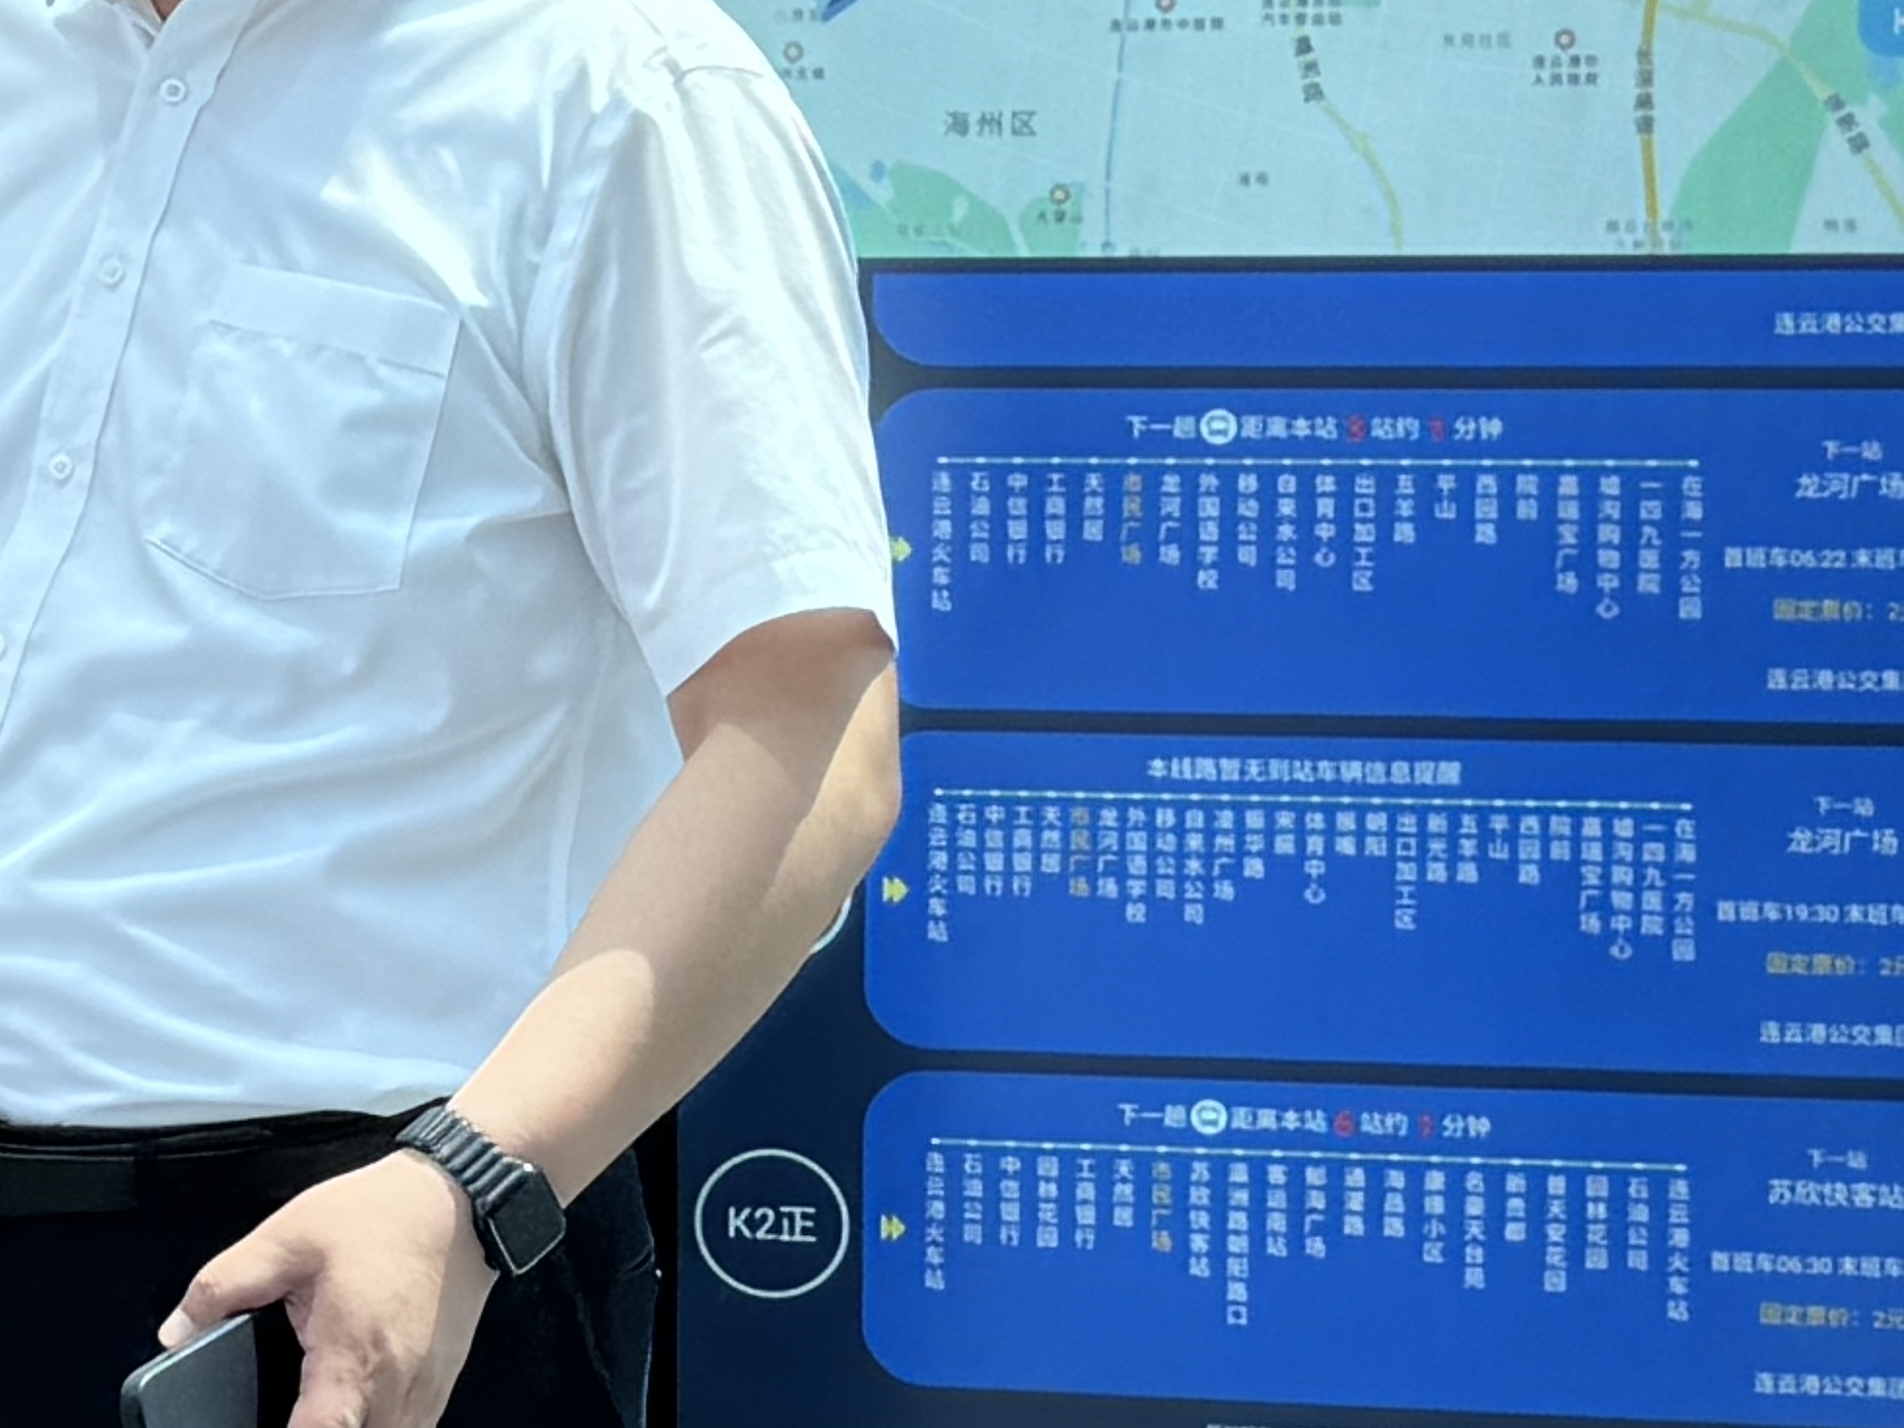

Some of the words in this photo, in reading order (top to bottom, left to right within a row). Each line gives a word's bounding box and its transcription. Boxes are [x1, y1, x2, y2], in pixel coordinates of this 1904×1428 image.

[944, 110, 1038, 137] 海州区
[1786, 828, 1900, 857] 龙河广场
[728, 1204, 818, 1243] K2正
